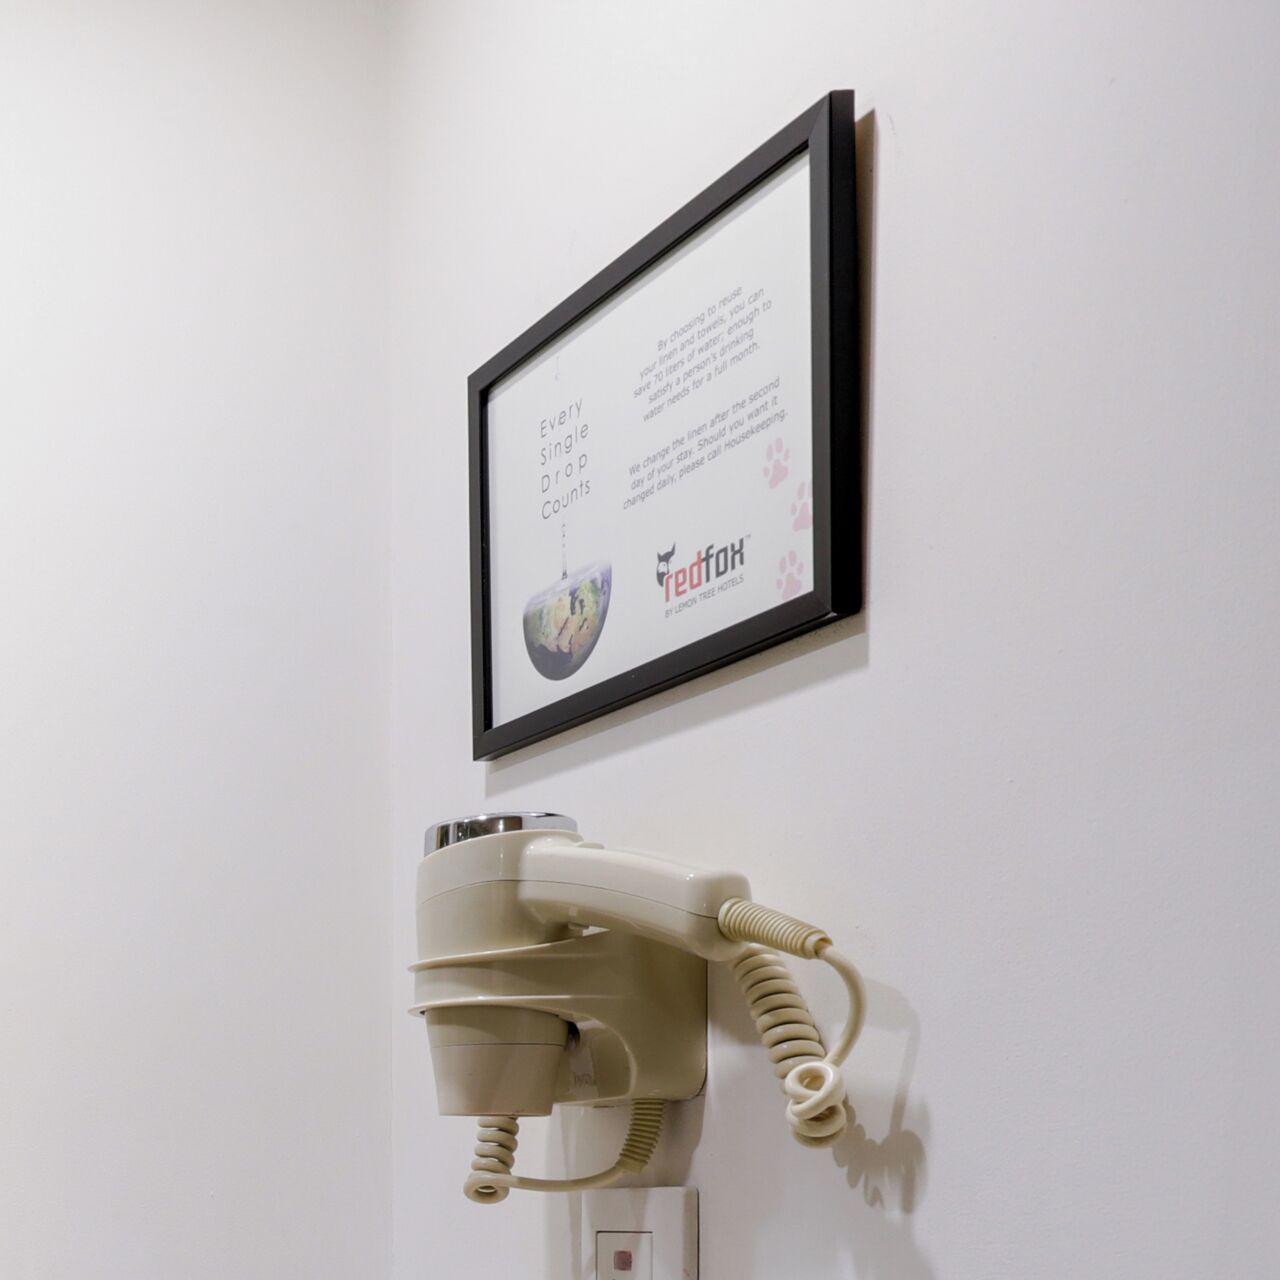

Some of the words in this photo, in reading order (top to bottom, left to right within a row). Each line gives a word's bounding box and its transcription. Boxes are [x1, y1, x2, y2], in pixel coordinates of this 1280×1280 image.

[639, 361, 657, 379] your
[659, 348, 678, 365] linen
[680, 334, 695, 351] and
[729, 301, 745, 319] you
[747, 288, 764, 305] can
[669, 312, 706, 344] choosing
[707, 305, 717, 317] to
[718, 286, 743, 309] reuse
[633, 381, 652, 399] save
[654, 370, 664, 385] 70
[665, 357, 685, 378] liters
[686, 348, 696, 362] of
[726, 307, 760, 336] enough
[762, 299, 772, 313] to
[648, 381, 675, 404] satisfy
[719, 327, 754, 358] drinking
[540, 397, 582, 439] Every
[643, 401, 665, 422] water
[666, 385, 690, 408] needs
[692, 376, 705, 392] for
[714, 359, 729, 377] full
[540, 423, 589, 466] Single
[629, 463, 641, 477] We
[642, 445, 671, 469] change
[672, 437, 685, 452] the
[687, 422, 708, 441] linen
[709, 408, 731, 429] after
[732, 398, 747, 415] the
[748, 376, 781, 404] second
[631, 477, 645, 491] day
[647, 467, 655, 481] of
[657, 457, 675, 476] your
[697, 425, 727, 452] Should
[729, 417, 745, 433] you
[747, 399, 769, 421] want
[771, 395, 779, 408] it
[541, 453, 588, 494] Drop
[541, 479, 591, 520] Counts
[623, 484, 655, 510] changed
[679, 456, 705, 480] please
[707, 444, 722, 462] call
[664, 537, 744, 603] redfox
